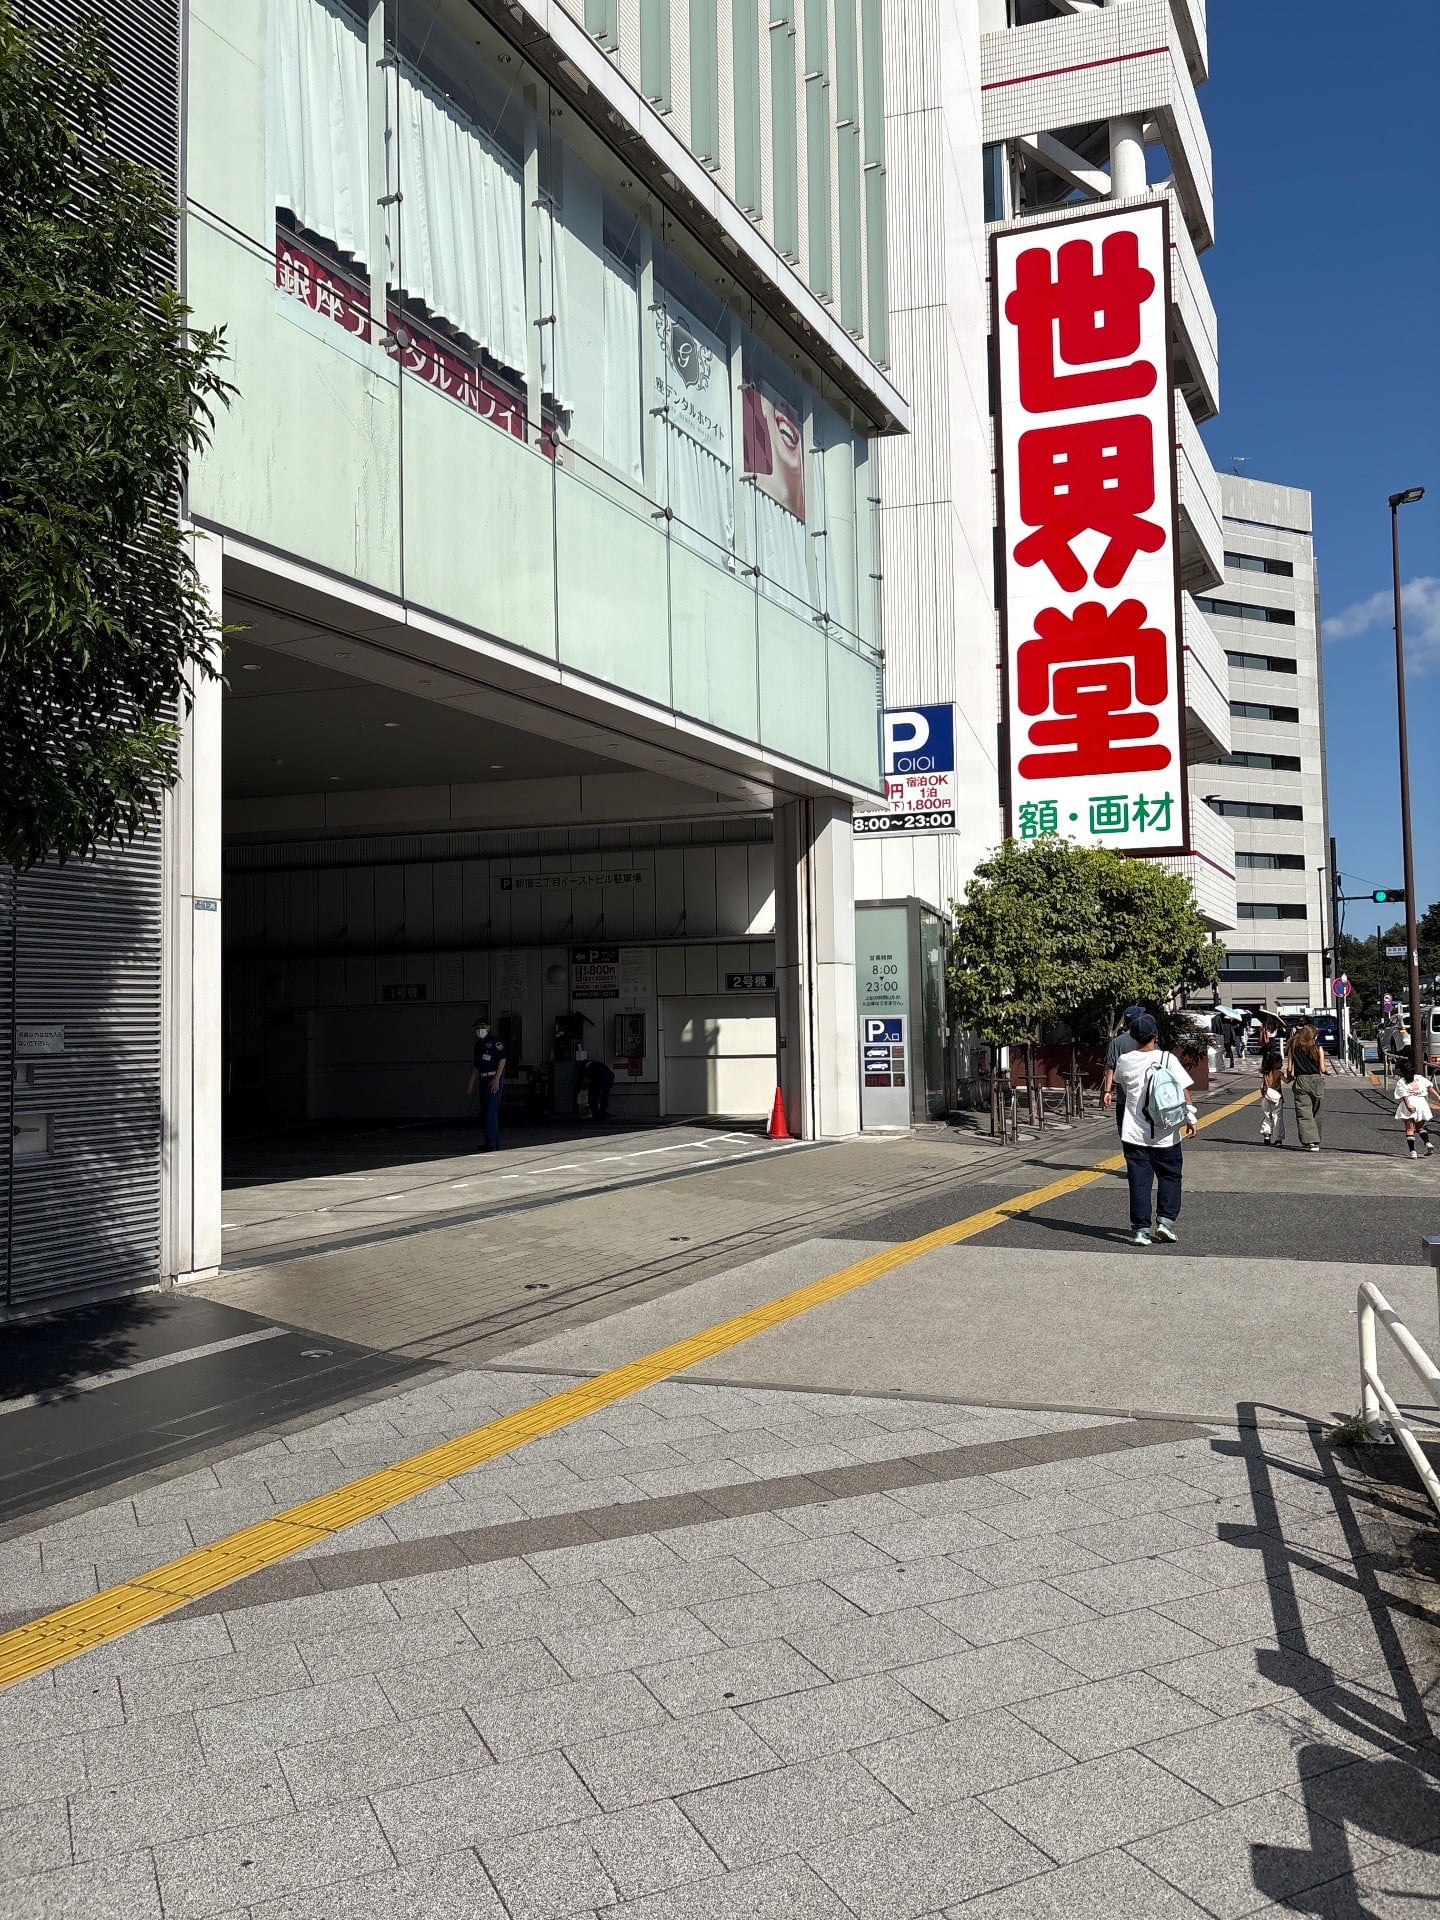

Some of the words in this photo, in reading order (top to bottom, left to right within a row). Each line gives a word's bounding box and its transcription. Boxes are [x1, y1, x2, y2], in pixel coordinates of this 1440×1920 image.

[1005, 231, 1171, 780] 世界堂
[880, 711, 930, 775] P
[906, 774, 949, 787] 宿泊OK
[919, 787, 938, 798] 1泊
[907, 798, 952, 812] 1,800円
[1018, 791, 1175, 840] 額・画材
[589, 950, 600, 963] P
[872, 964, 898, 975] 8:00
[733, 975, 767, 988] 2号機
[865, 981, 898, 992] 23:00
[867, 1020, 885, 1042] P
[883, 1033, 900, 1042] 入口
